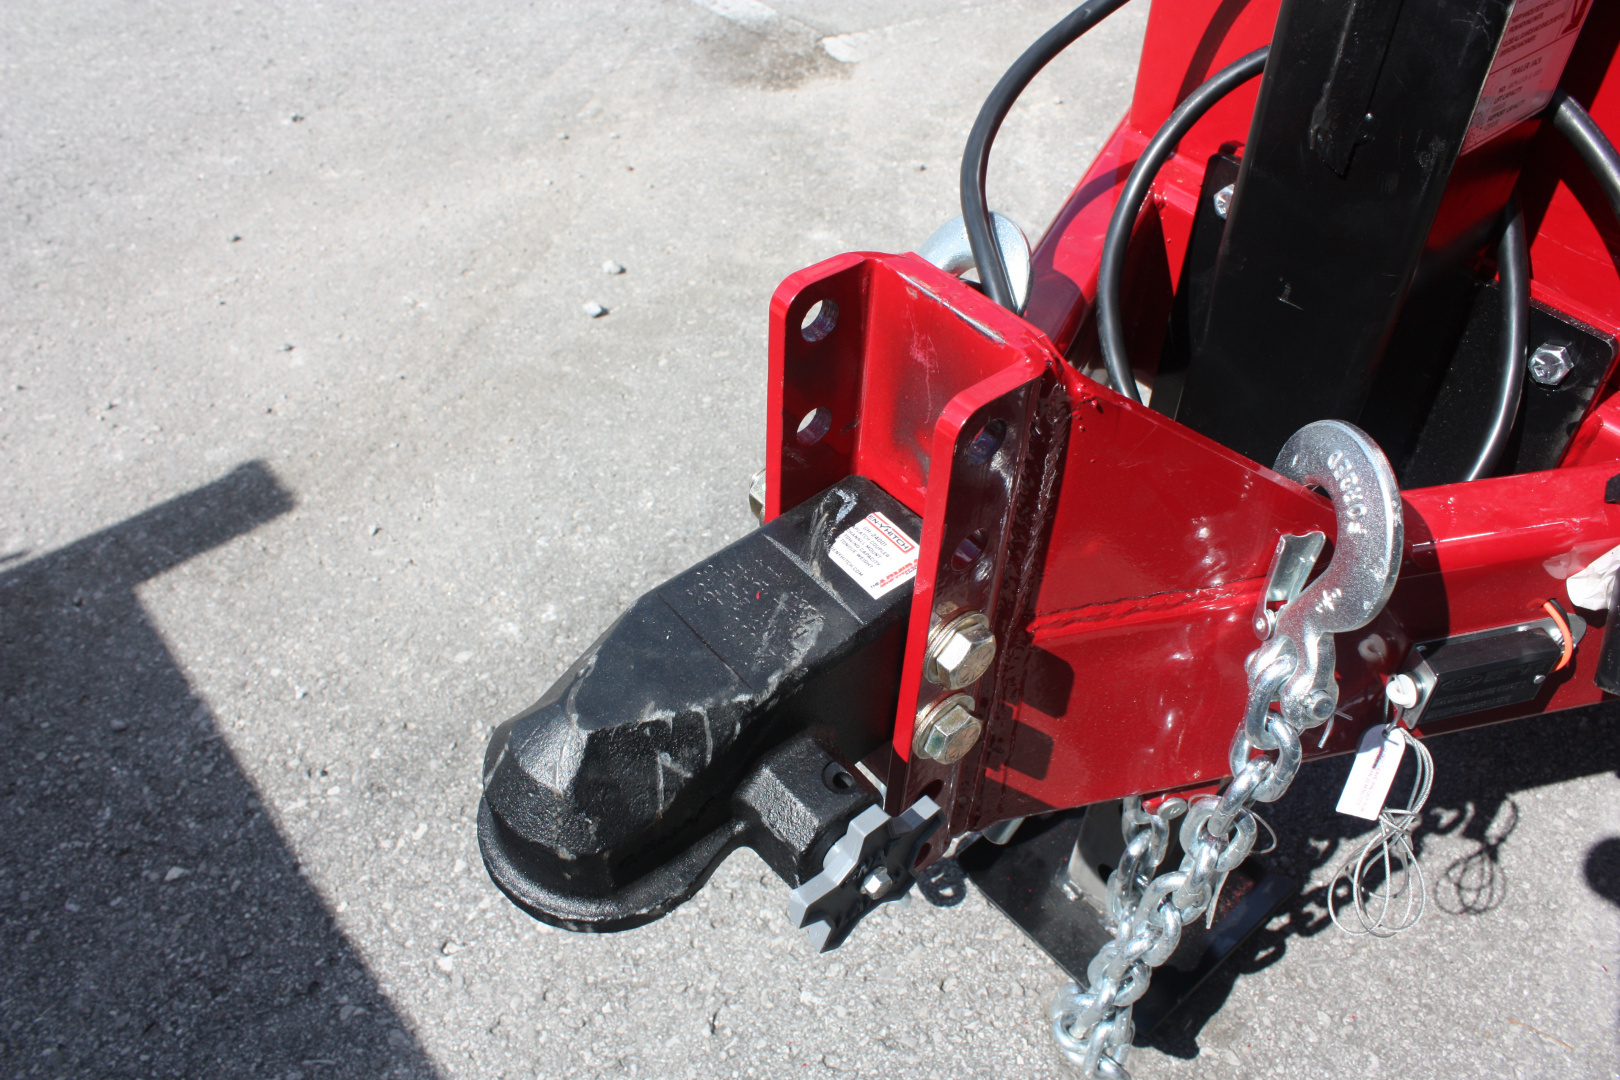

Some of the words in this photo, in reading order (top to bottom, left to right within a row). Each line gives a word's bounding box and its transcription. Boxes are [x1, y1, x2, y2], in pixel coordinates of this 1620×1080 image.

[1511, 62, 1530, 77] TRAILER
[1529, 56, 1543, 68] JACK
[884, 528, 909, 550] HITCH
[857, 553, 874, 568] WEIGHT
[860, 548, 880, 566] CAPACITY
